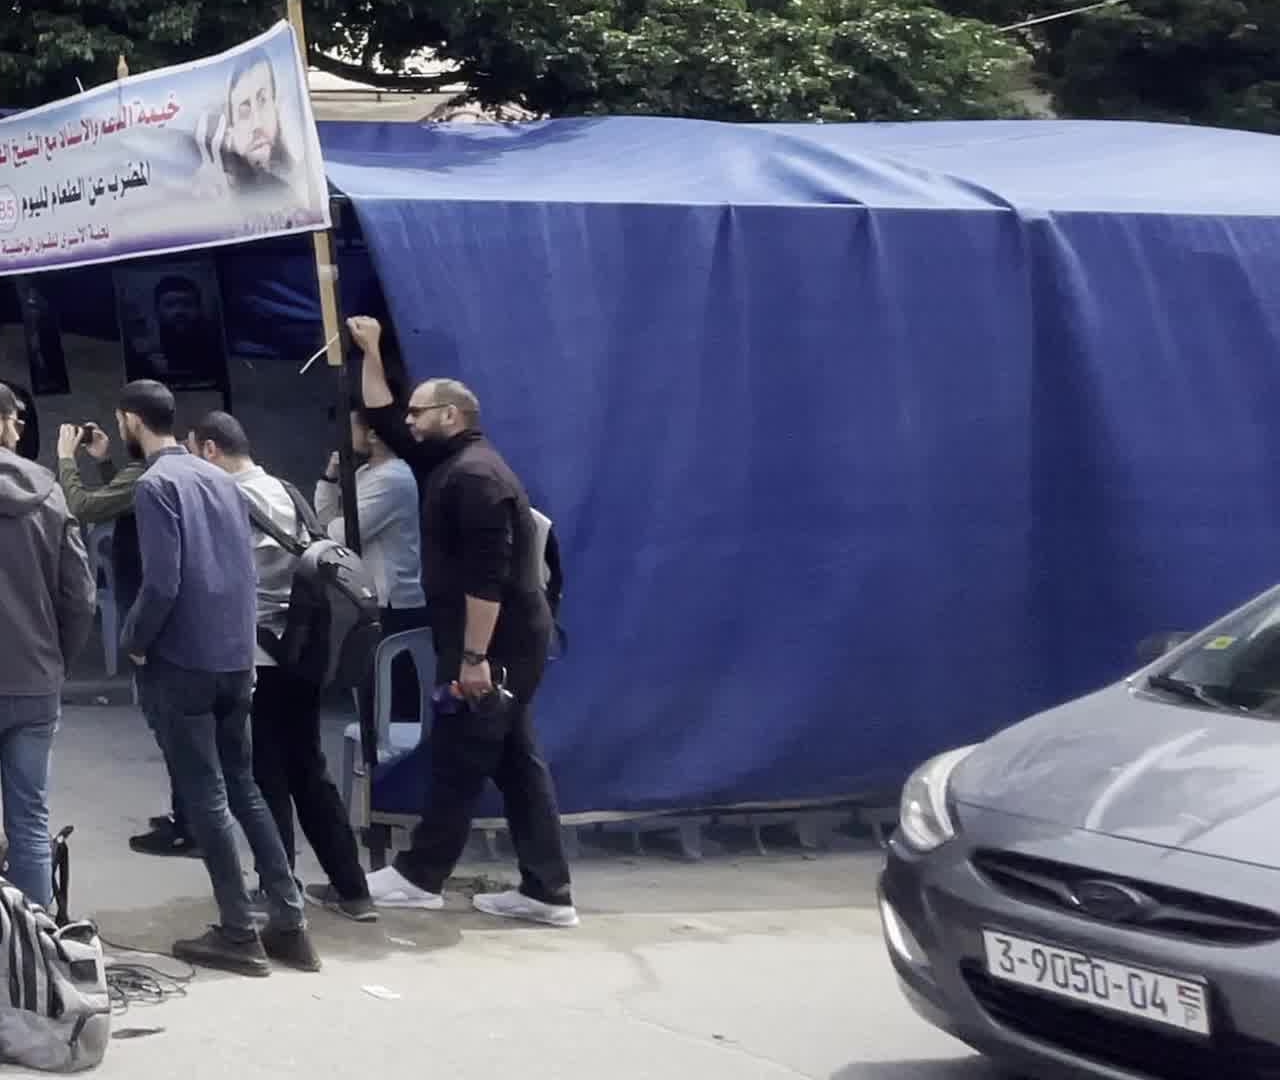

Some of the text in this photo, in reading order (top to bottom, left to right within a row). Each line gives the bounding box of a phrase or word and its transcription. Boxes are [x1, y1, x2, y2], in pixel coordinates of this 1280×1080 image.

[138, 93, 181, 128] خيمة
[13, 131, 42, 167] الشيخ
[51, 175, 86, 212] الطعام
[89, 178, 105, 206] عن
[107, 160, 151, 200] المضرب
[21, 184, 48, 219] لليوم
[995, 937, 1168, 1017] 3-9050-04
